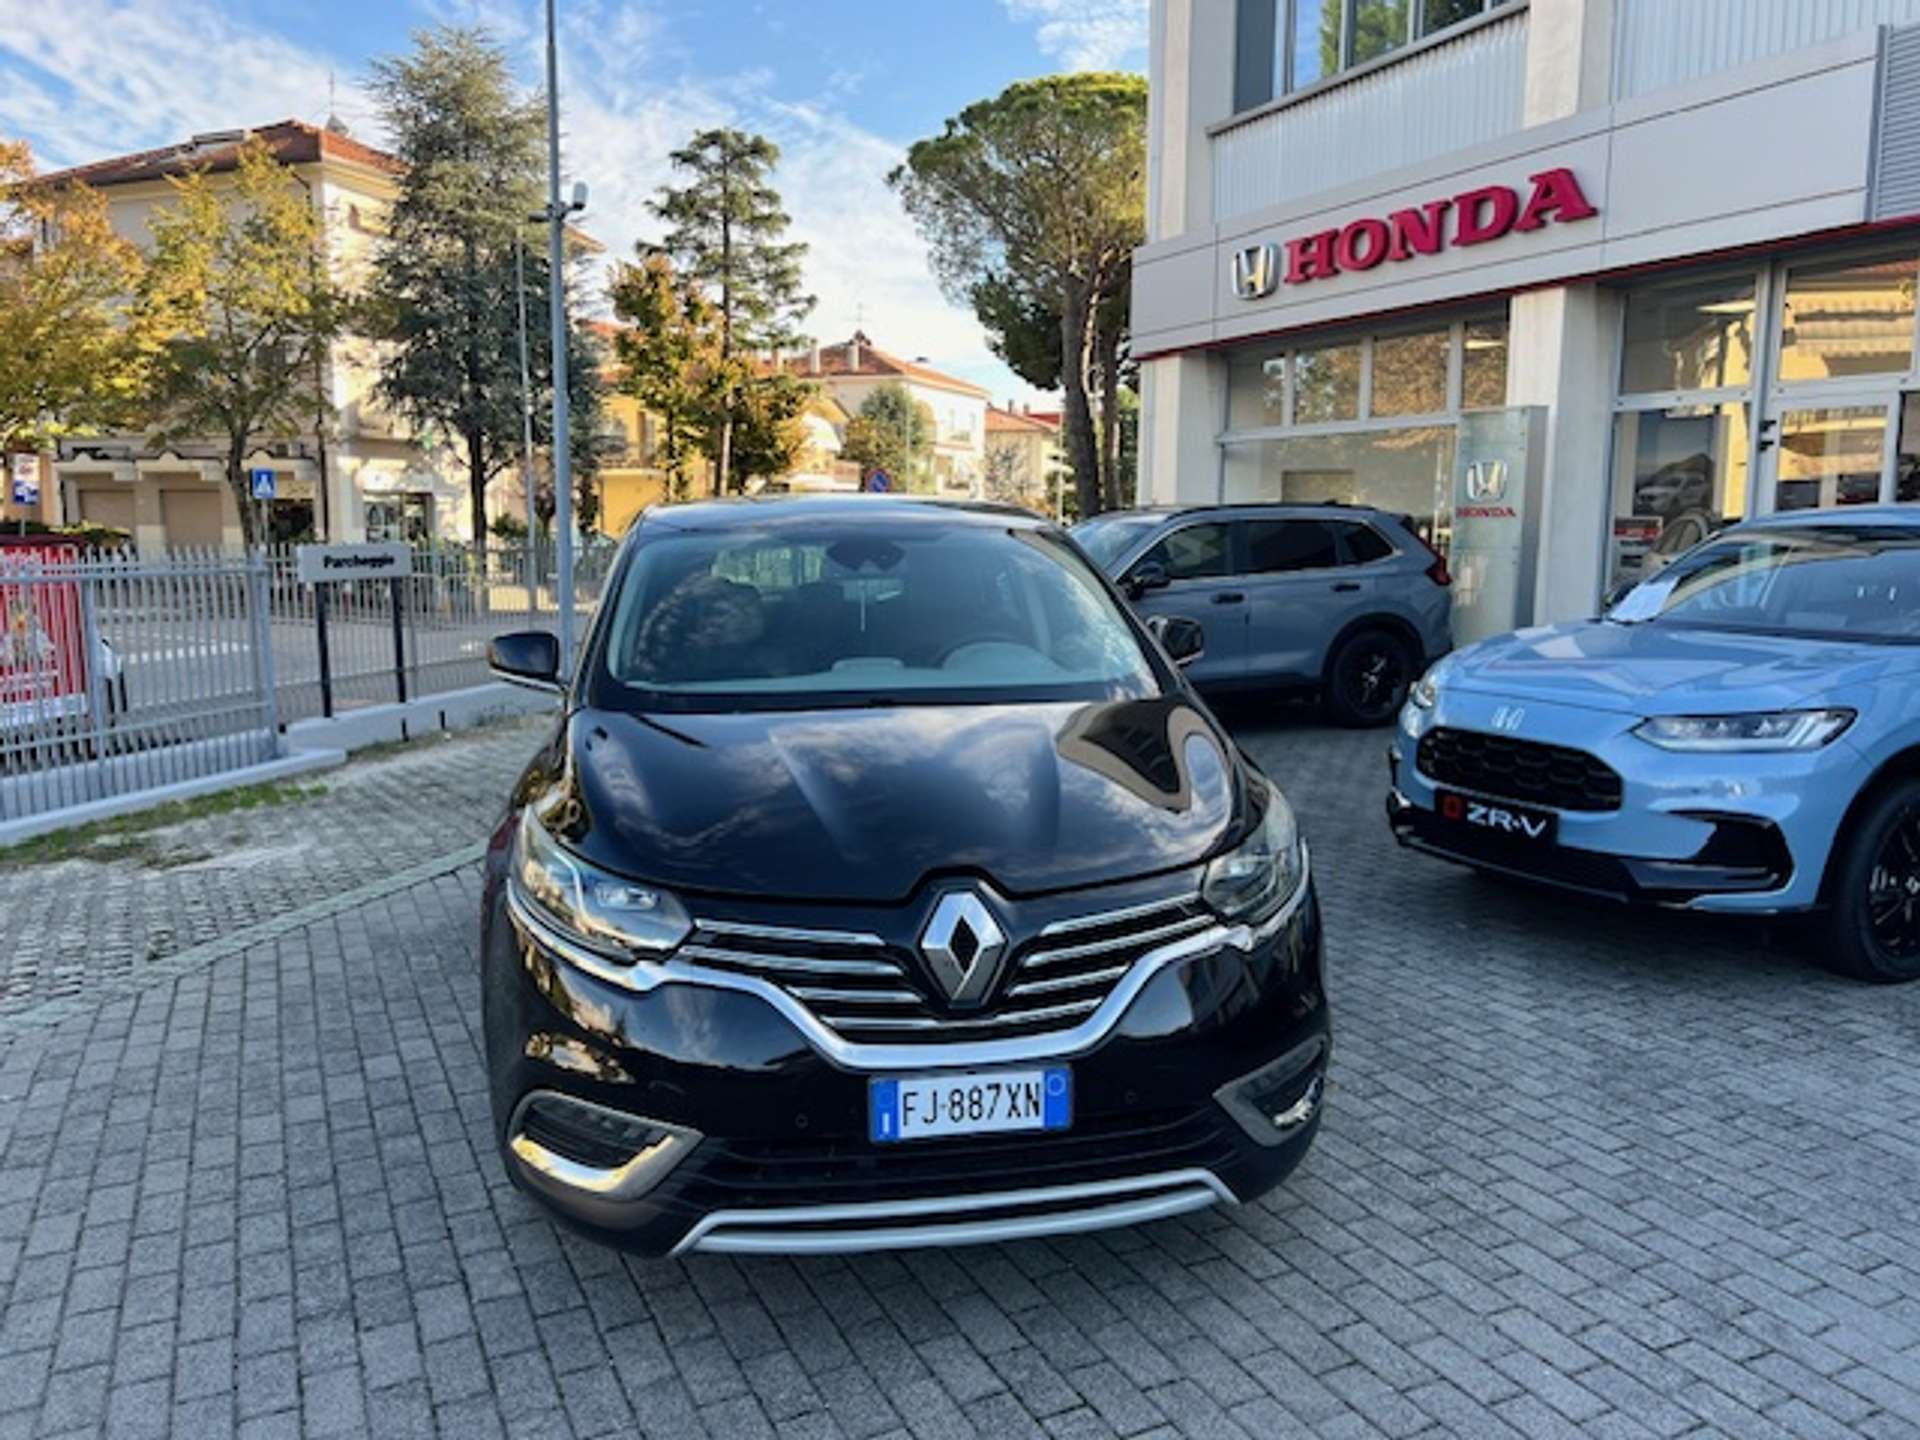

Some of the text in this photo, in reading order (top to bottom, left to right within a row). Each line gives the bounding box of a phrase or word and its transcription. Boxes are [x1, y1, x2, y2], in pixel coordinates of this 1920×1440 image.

[1284, 167, 1598, 284] HONDA
[1456, 506, 1516, 518] HONDA
[323, 554, 395, 570] Parcheggio
